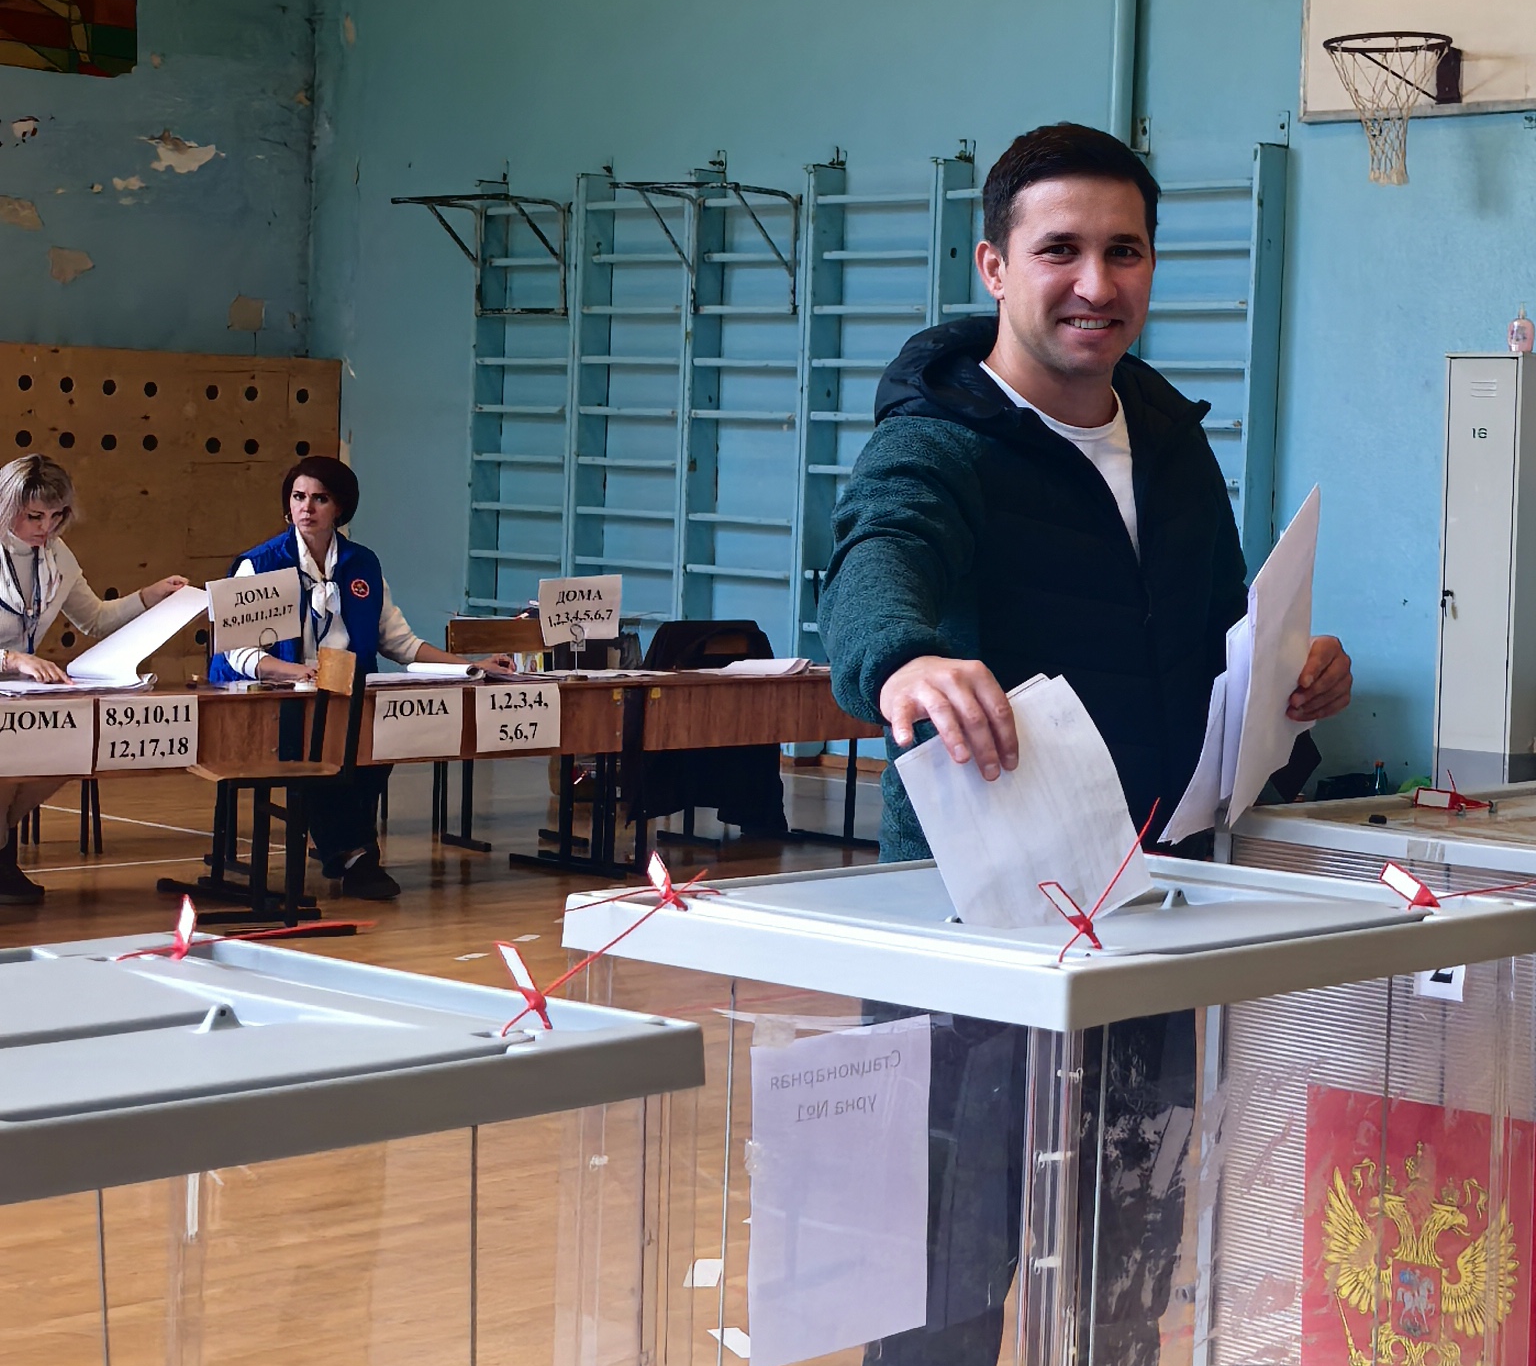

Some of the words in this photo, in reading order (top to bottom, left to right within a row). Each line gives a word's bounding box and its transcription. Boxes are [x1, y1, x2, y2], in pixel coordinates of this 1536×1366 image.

[234, 586, 280, 608] ДОМА
[555, 589, 603, 607] ДОМА
[547, 609, 613, 628] 1,2,3,4,5,6,7
[382, 698, 450, 721] ДОМА
[489, 690, 549, 713] 1,2,3,4,
[0, 710, 78, 735] ДОМА
[105, 704, 192, 729] 8,9,10,11
[499, 722, 539, 744] 5,6,7
[109, 737, 189, 761] 12,17,18
